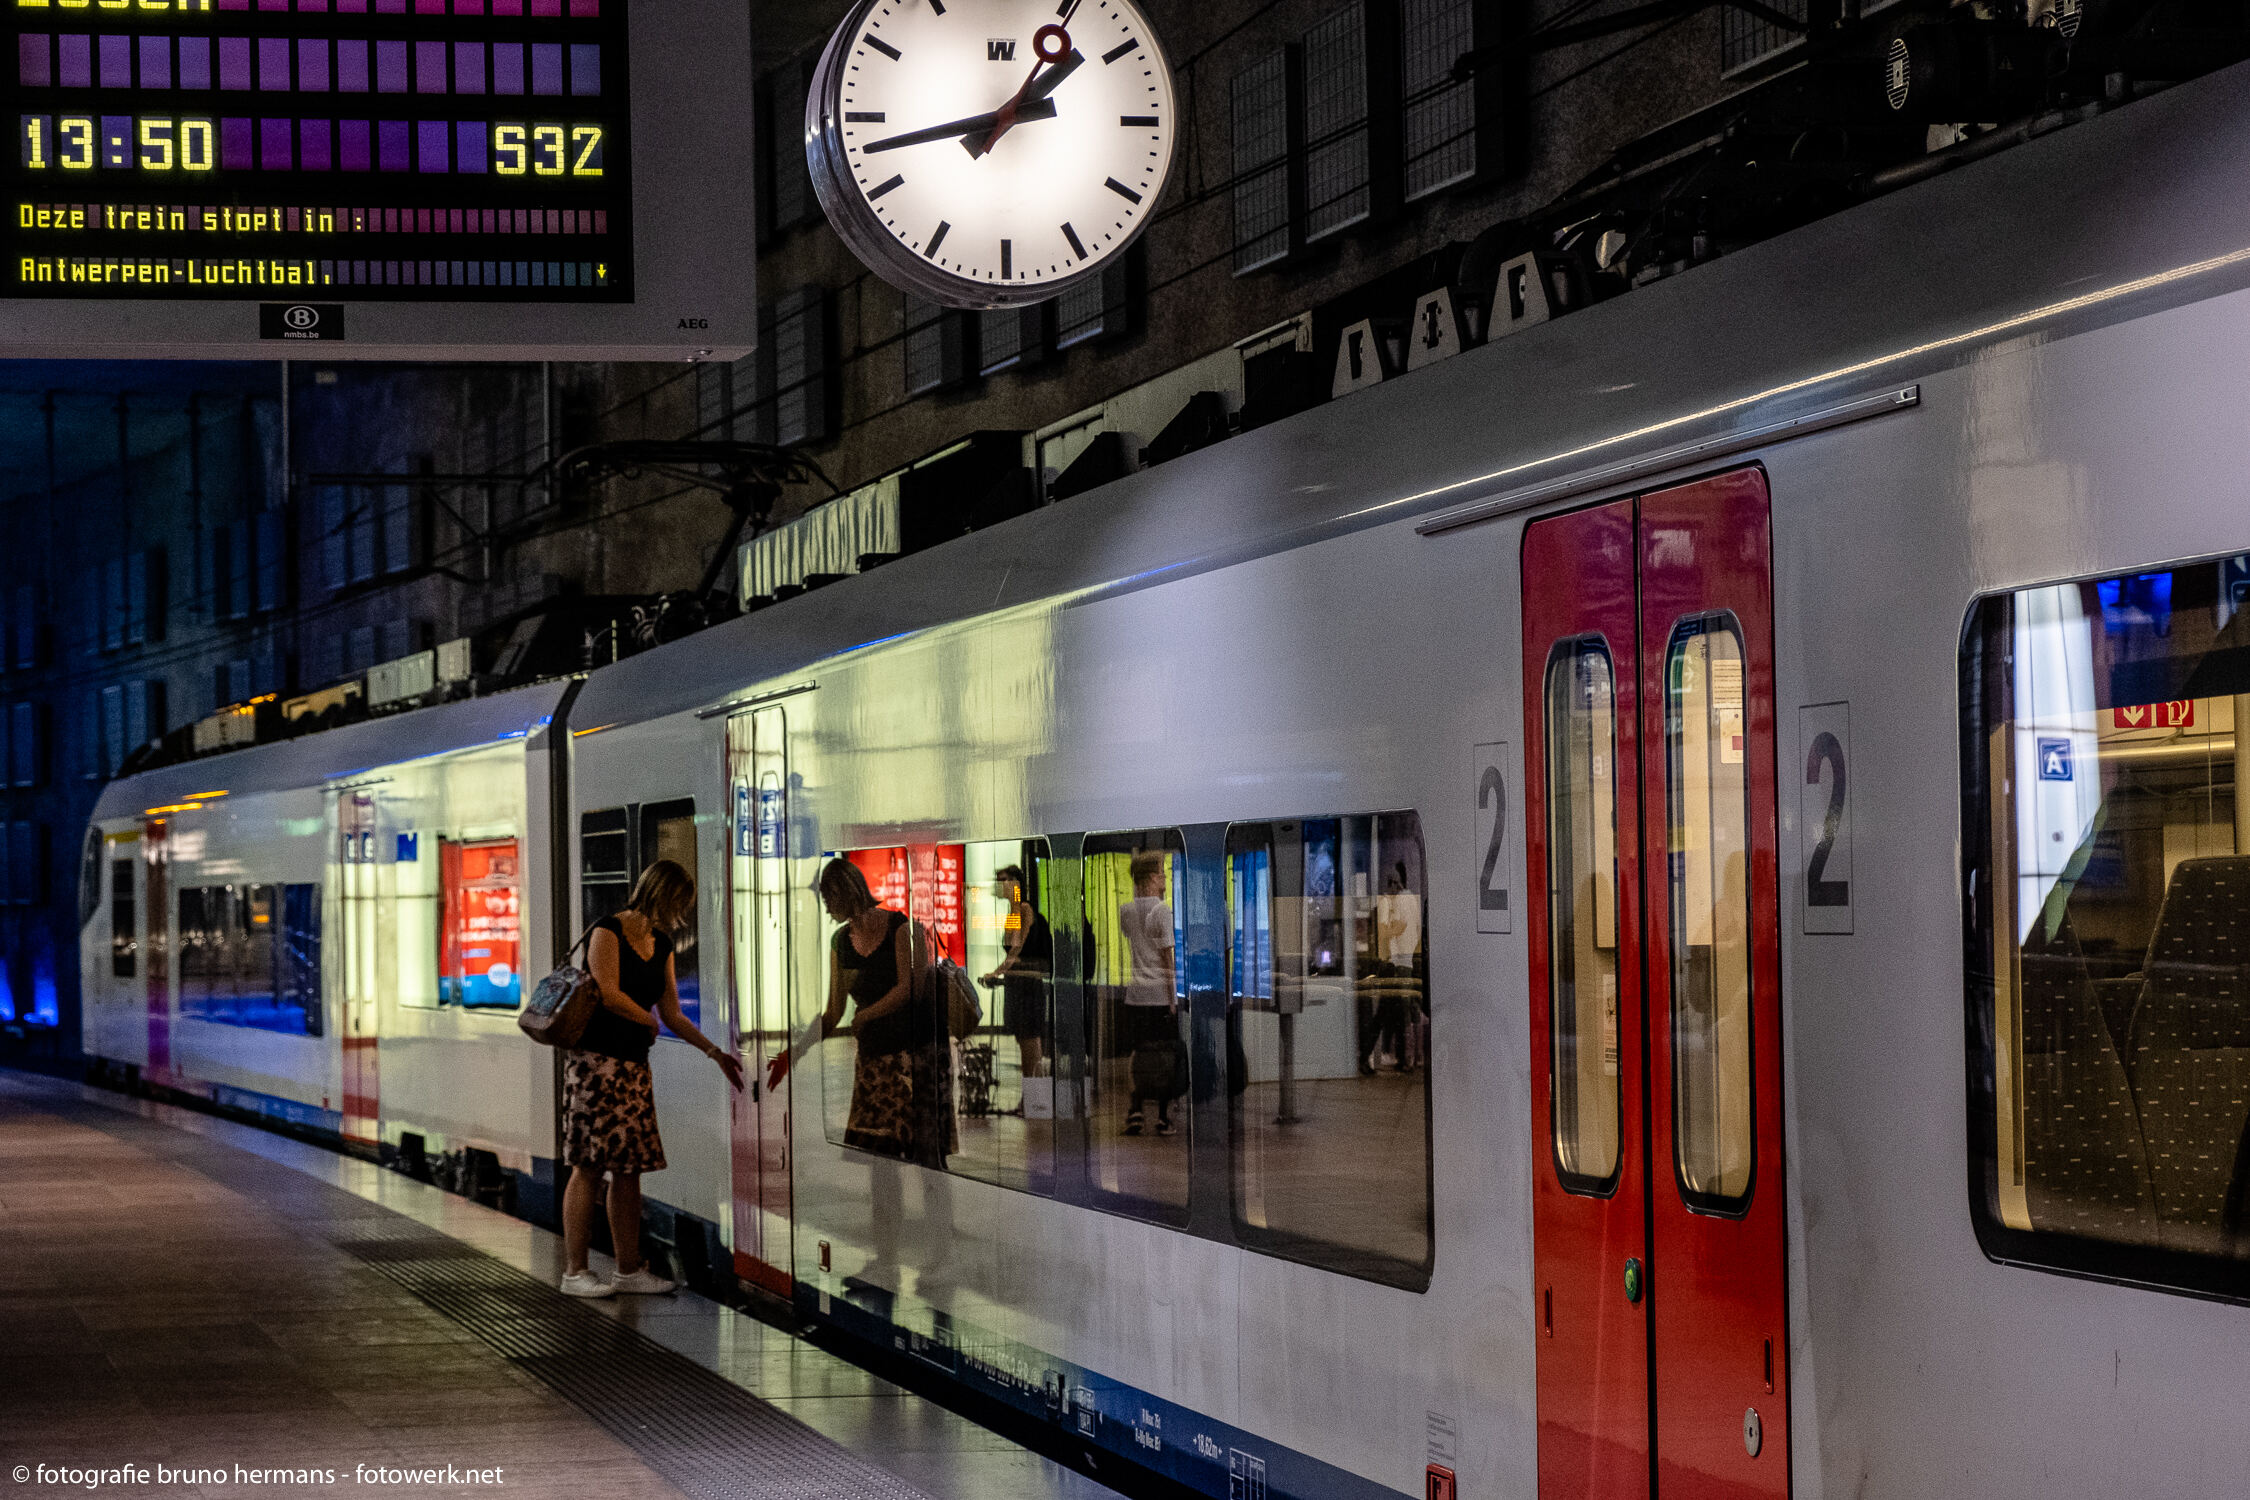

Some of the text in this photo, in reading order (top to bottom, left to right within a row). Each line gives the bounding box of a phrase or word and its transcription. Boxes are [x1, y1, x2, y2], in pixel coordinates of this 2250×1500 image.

[28, 118, 603, 176] 13:50 S32
[20, 204, 84, 229] Deze
[106, 205, 184, 231] trein
[203, 207, 281, 232] stopt
[305, 209, 333, 233] in
[22, 257, 330, 286] Antwerpen-Luchtbal,
[284, 330, 319, 339] nmbs.be
[677, 318, 709, 330] AEG
[1807, 731, 1850, 907] 2
[1478, 766, 1508, 911] 2
